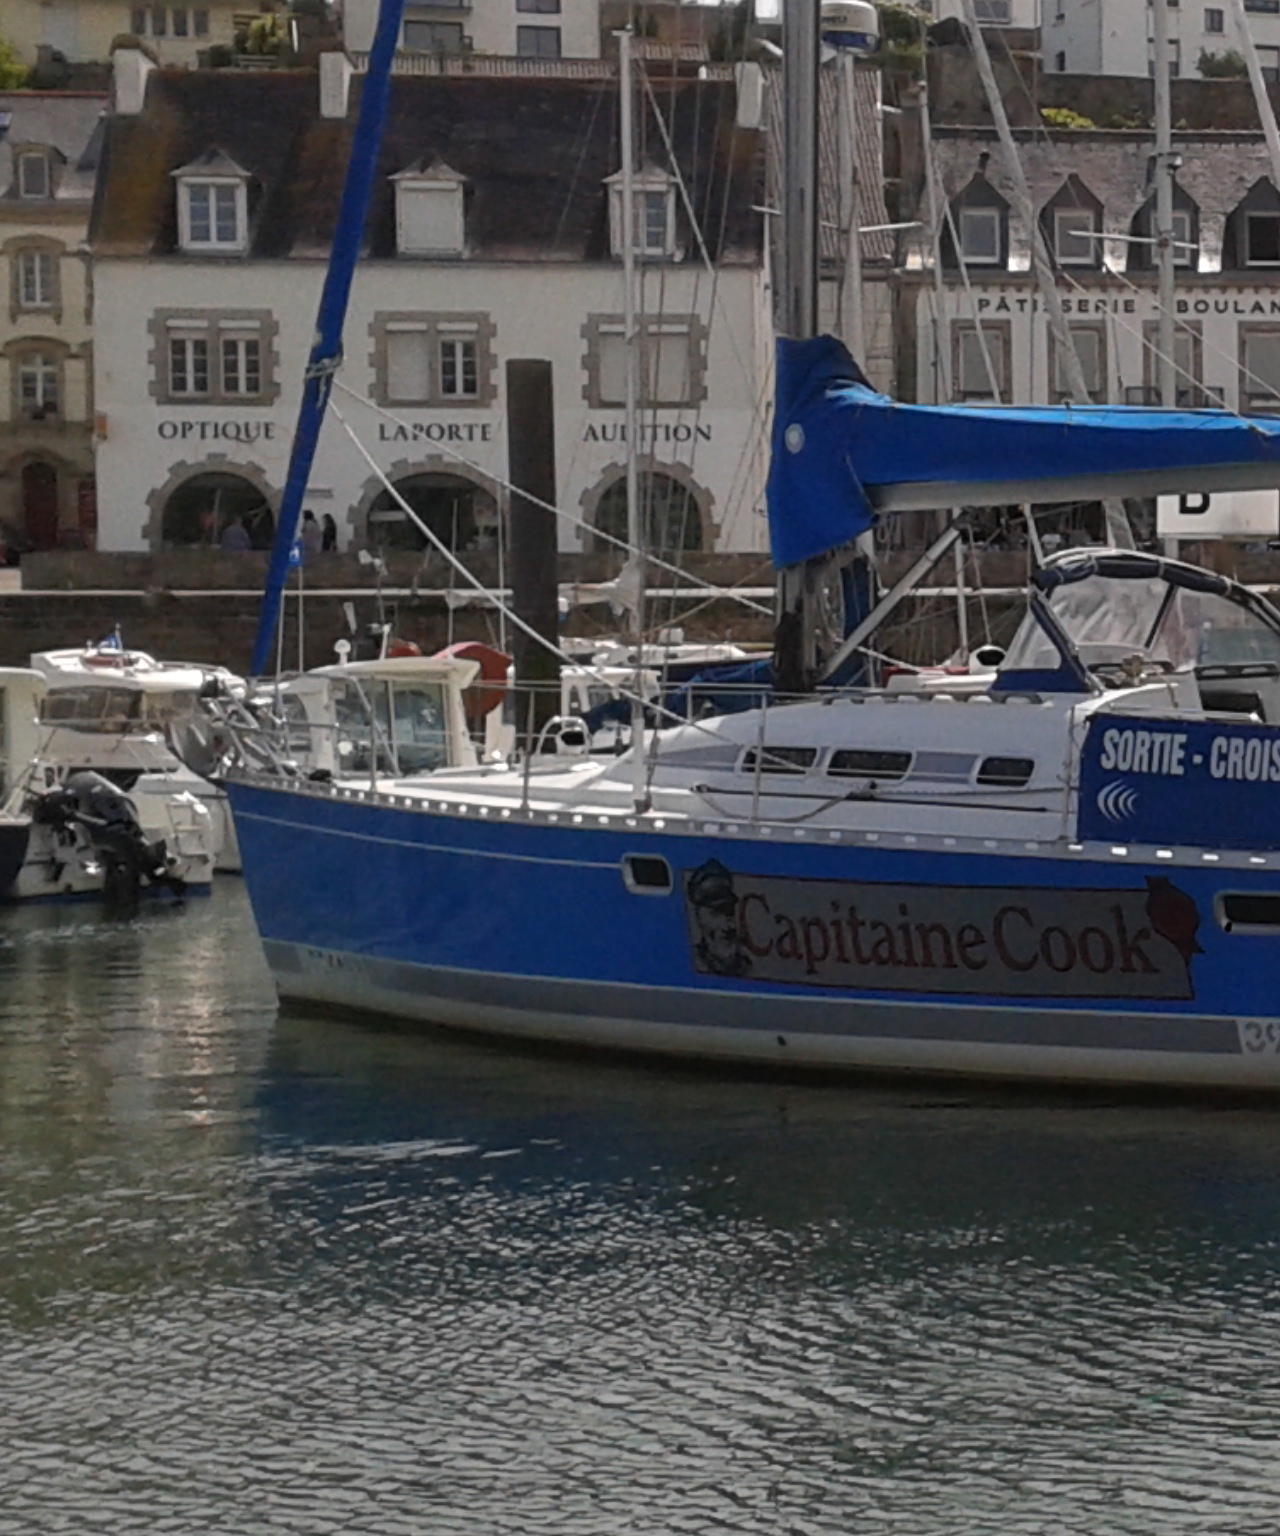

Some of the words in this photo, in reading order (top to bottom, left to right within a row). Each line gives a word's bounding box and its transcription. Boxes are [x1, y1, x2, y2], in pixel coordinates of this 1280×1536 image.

[157, 420, 276, 443] OPTIQUE
[378, 422, 493, 442] LAPORTE
[1099, 728, 1189, 776] SORTIE
[738, 892, 989, 975] Capitaine
[992, 903, 1161, 975] Cook
